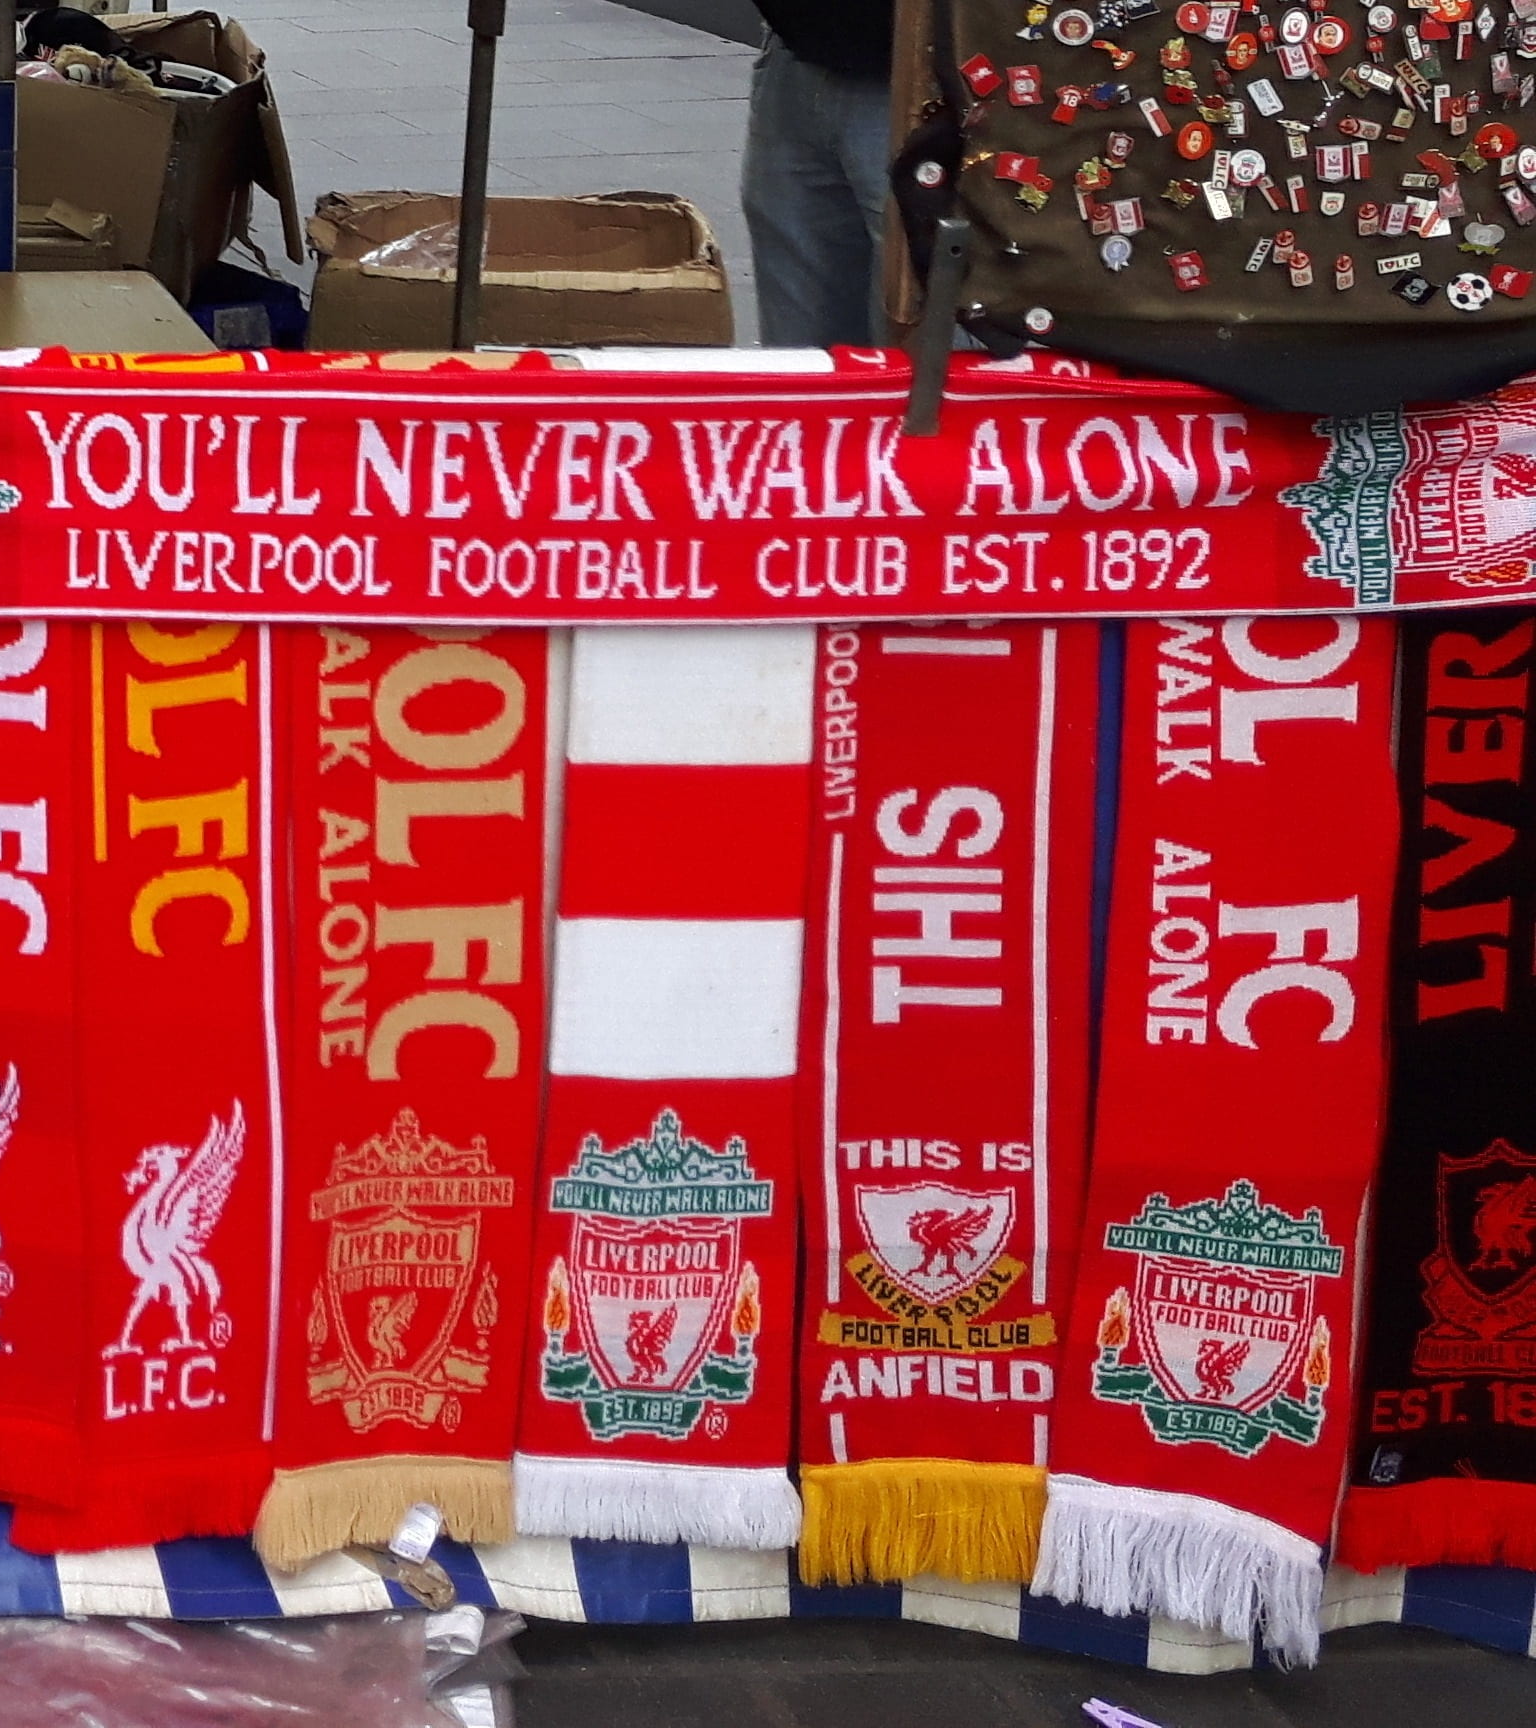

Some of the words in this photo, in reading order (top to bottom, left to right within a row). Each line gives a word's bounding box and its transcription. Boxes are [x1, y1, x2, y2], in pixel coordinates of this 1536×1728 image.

[26, 410, 321, 516] YOU'LL
[351, 418, 654, 522] NEVER
[671, 417, 925, 520] WALK
[956, 413, 1256, 518] ALONE
[67, 528, 391, 596] LIVERPOOL
[428, 536, 718, 600] FOOTBALL
[757, 535, 908, 598] CLUB
[942, 531, 1064, 594] EST.
[1083, 529, 1211, 591] 1892
[318, 808, 369, 1067] ALONE
[873, 787, 1002, 1023] THIS
[1146, 839, 1211, 1044] ALONE
[367, 896, 523, 1081] FC
[840, 1140, 959, 1170] THIS
[982, 1141, 1032, 1171] IS
[1153, 1274, 1295, 1316] LIVERPOOL
[822, 1357, 1052, 1402] ANFIELD
